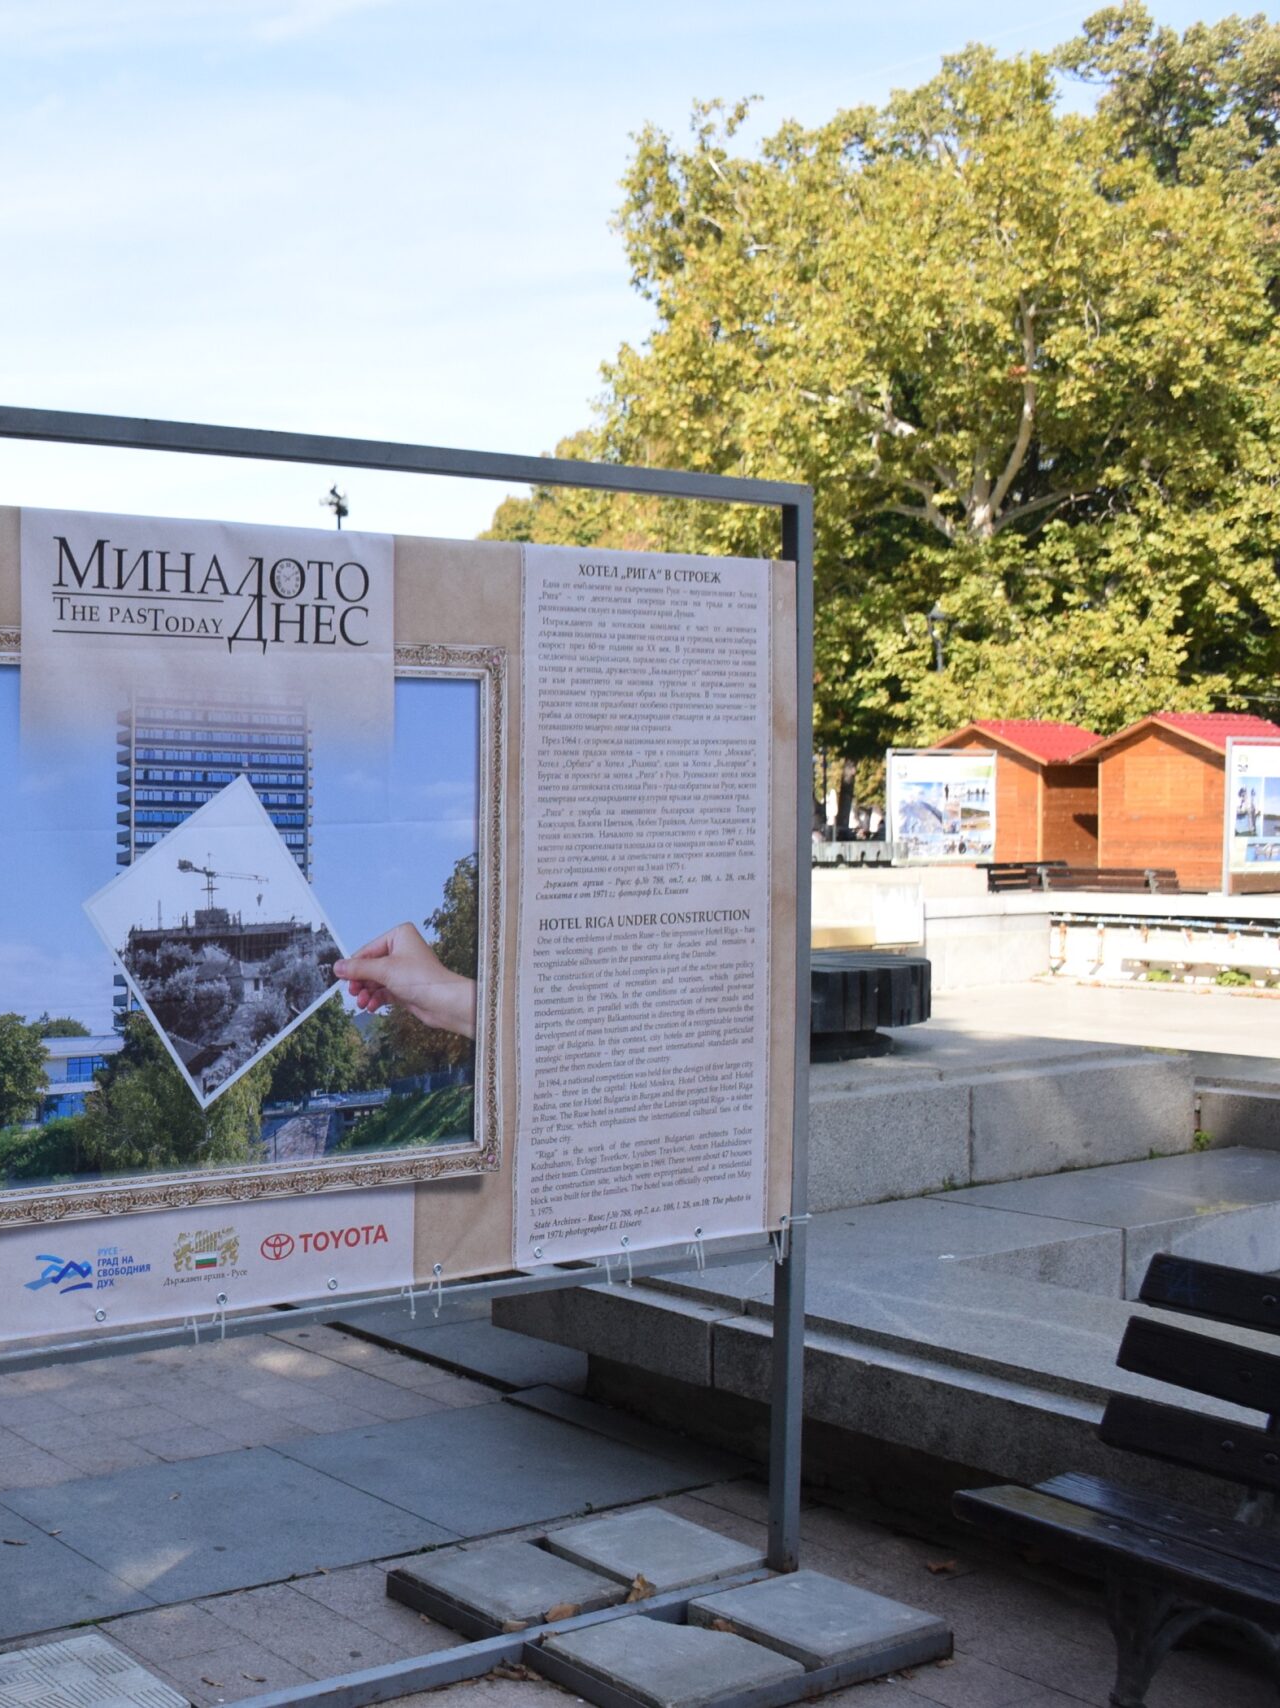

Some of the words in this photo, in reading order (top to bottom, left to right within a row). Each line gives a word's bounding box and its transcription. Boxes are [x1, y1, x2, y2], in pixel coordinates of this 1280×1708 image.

[578, 563, 619, 579] ХОТЕЛ
[665, 568, 672, 582] В
[673, 568, 721, 585] СТРОЕЖ
[538, 916, 582, 932] HOTEL
[584, 914, 615, 930] RIGA
[617, 912, 658, 928] UNDER
[660, 907, 751, 926] CONSTRUCTION
[299, 1224, 389, 1254] TOYOTA
[97, 1256, 119, 1268] ГРАД
[122, 1255, 134, 1264] НА
[97, 1263, 151, 1278] СВОБОДНИЯ
[96, 1278, 115, 1290] ДУХ
[163, 1274, 202, 1288] Държавен
[203, 1272, 225, 1284] архив
[231, 1268, 248, 1280] Русе
